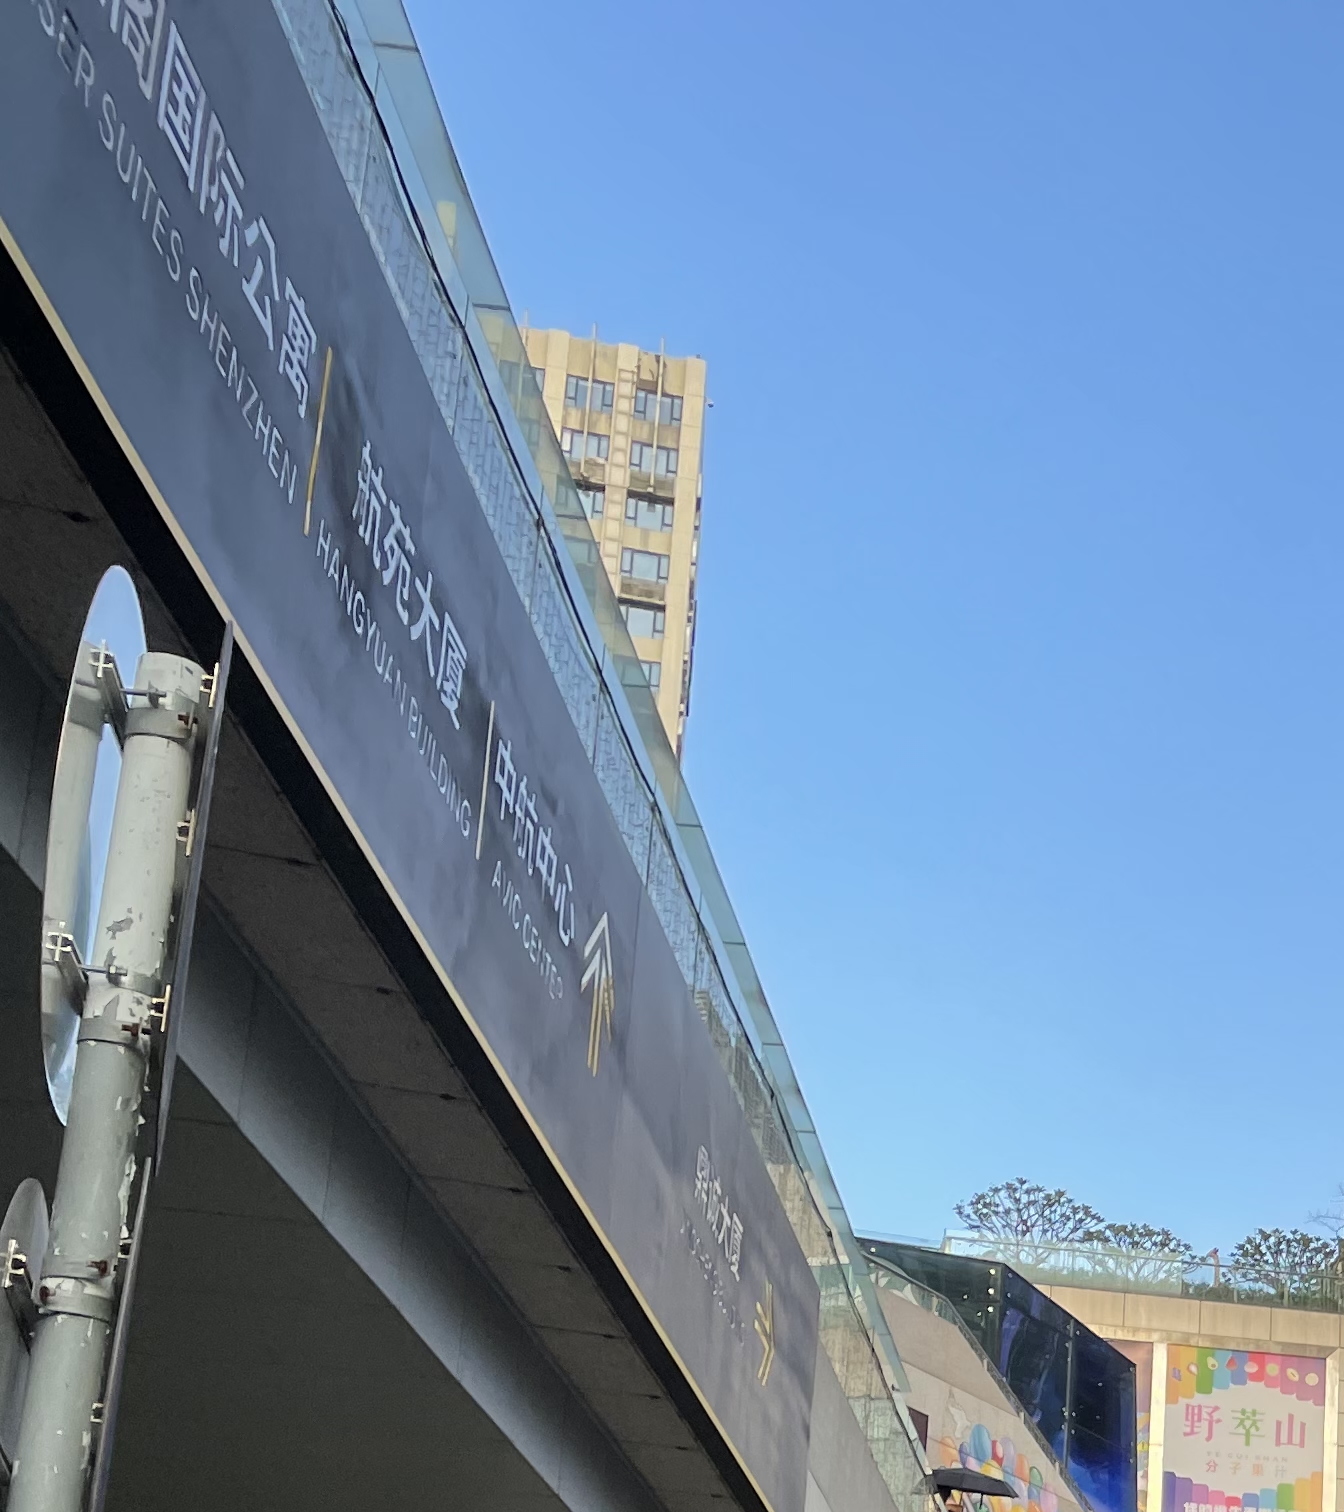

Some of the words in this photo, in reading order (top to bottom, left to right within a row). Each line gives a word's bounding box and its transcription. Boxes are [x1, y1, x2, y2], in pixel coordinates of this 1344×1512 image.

[98, 92, 185, 283] SUITES
[185, 266, 297, 504] SHENZHEN
[316, 519, 407, 717] HANGYUAN
[407, 696, 471, 839] BUILDING
[352, 440, 467, 731] 航苑大厦
[491, 860, 522, 930] AVIC
[494, 738, 575, 948] 中航中心
[1183, 1403, 1307, 1449] 野萃山
